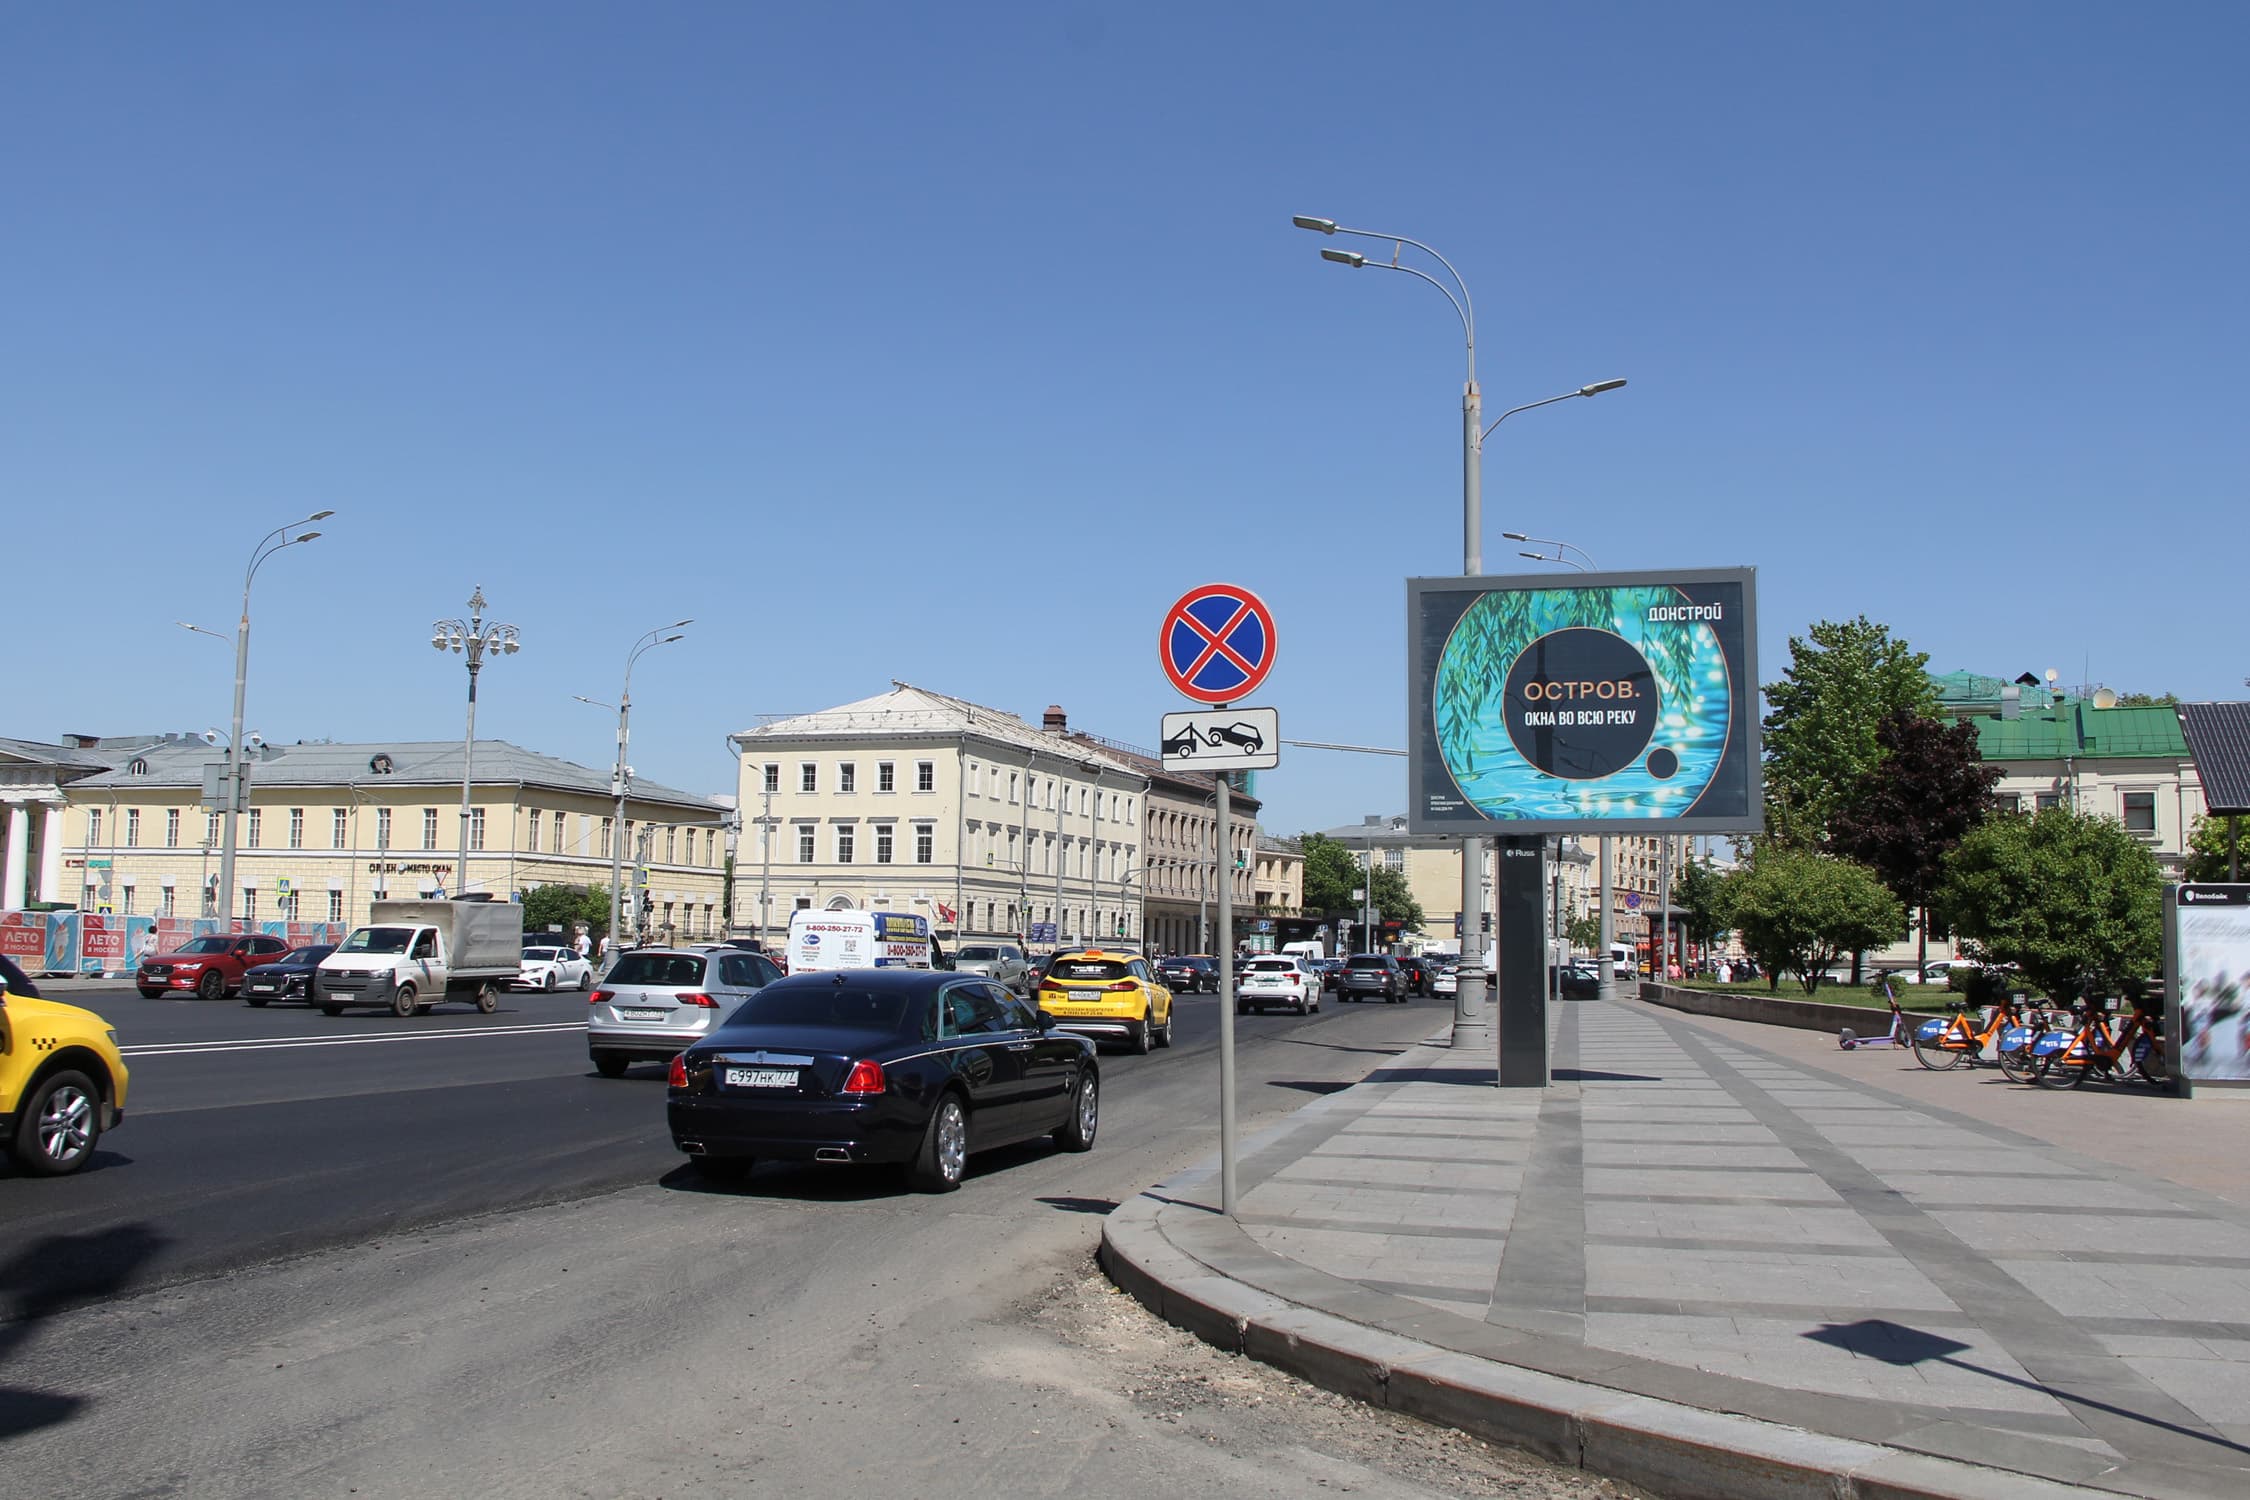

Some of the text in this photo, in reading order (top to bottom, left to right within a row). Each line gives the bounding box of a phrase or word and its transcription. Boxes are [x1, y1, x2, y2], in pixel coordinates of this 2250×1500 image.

[1648, 602, 1722, 622] ДОНСТРОЙ
[1523, 681, 1641, 701] ОСТРОВ.
[1525, 709, 1636, 727] ОКНА ВО ВСЮ РЕКУ
[1515, 849, 1536, 857] Russ
[5, 932, 40, 944] ЛЕТО
[88, 934, 120, 946] ЛЕТО
